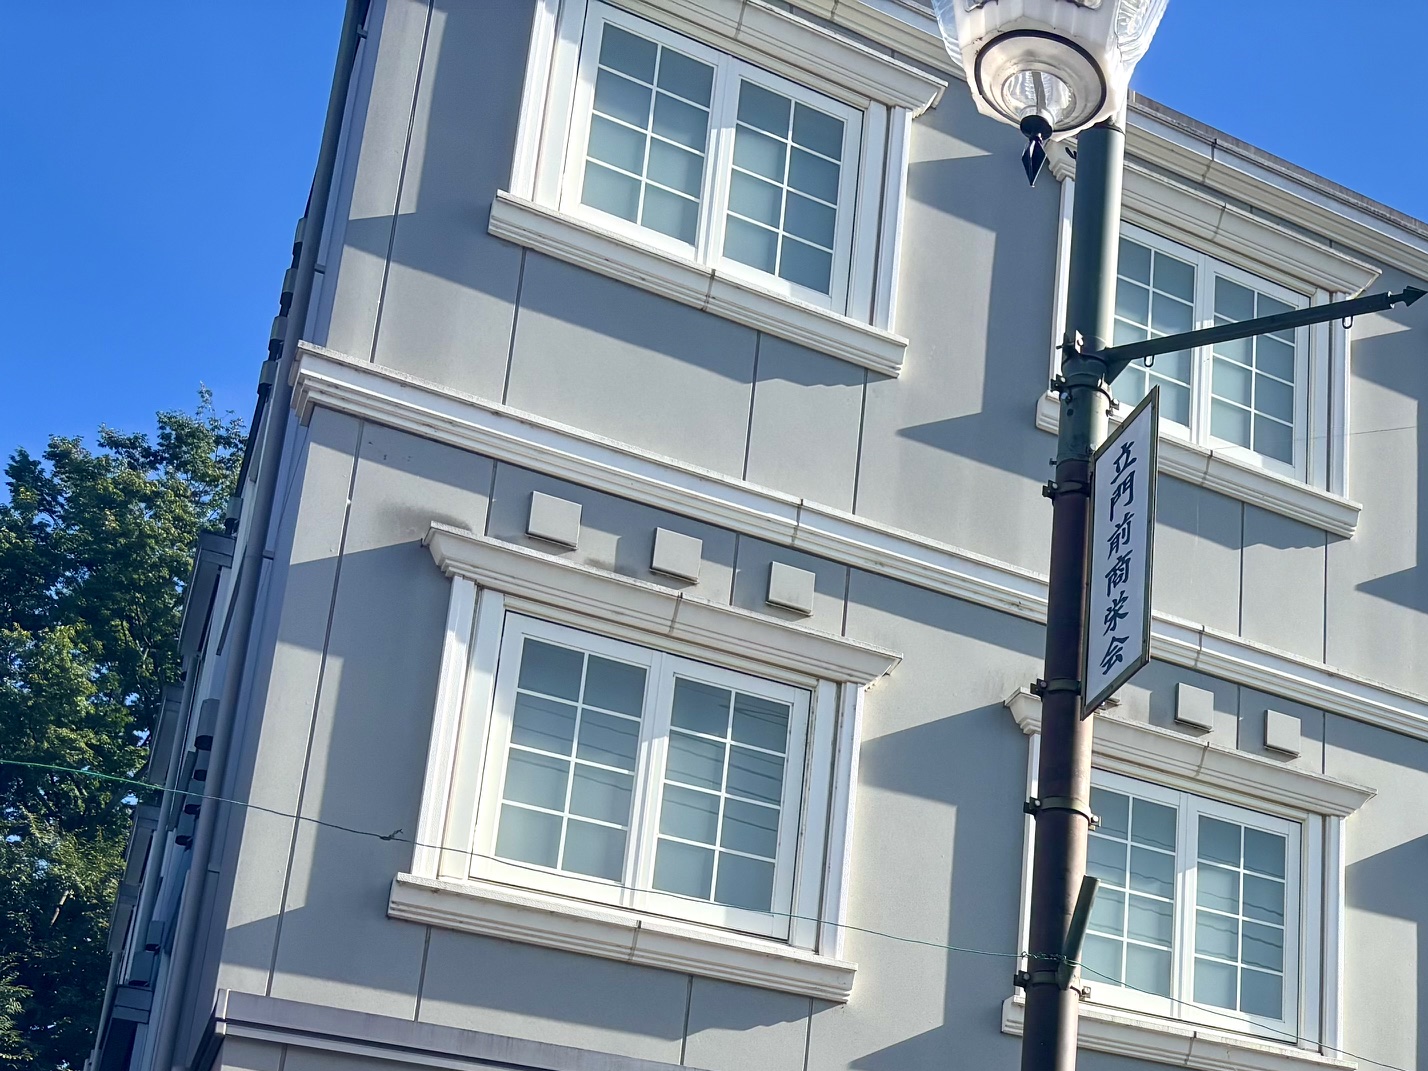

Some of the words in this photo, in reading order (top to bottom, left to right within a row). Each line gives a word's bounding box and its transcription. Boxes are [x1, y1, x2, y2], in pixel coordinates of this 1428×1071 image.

[1100, 440, 1137, 676] 立門前商栄会
